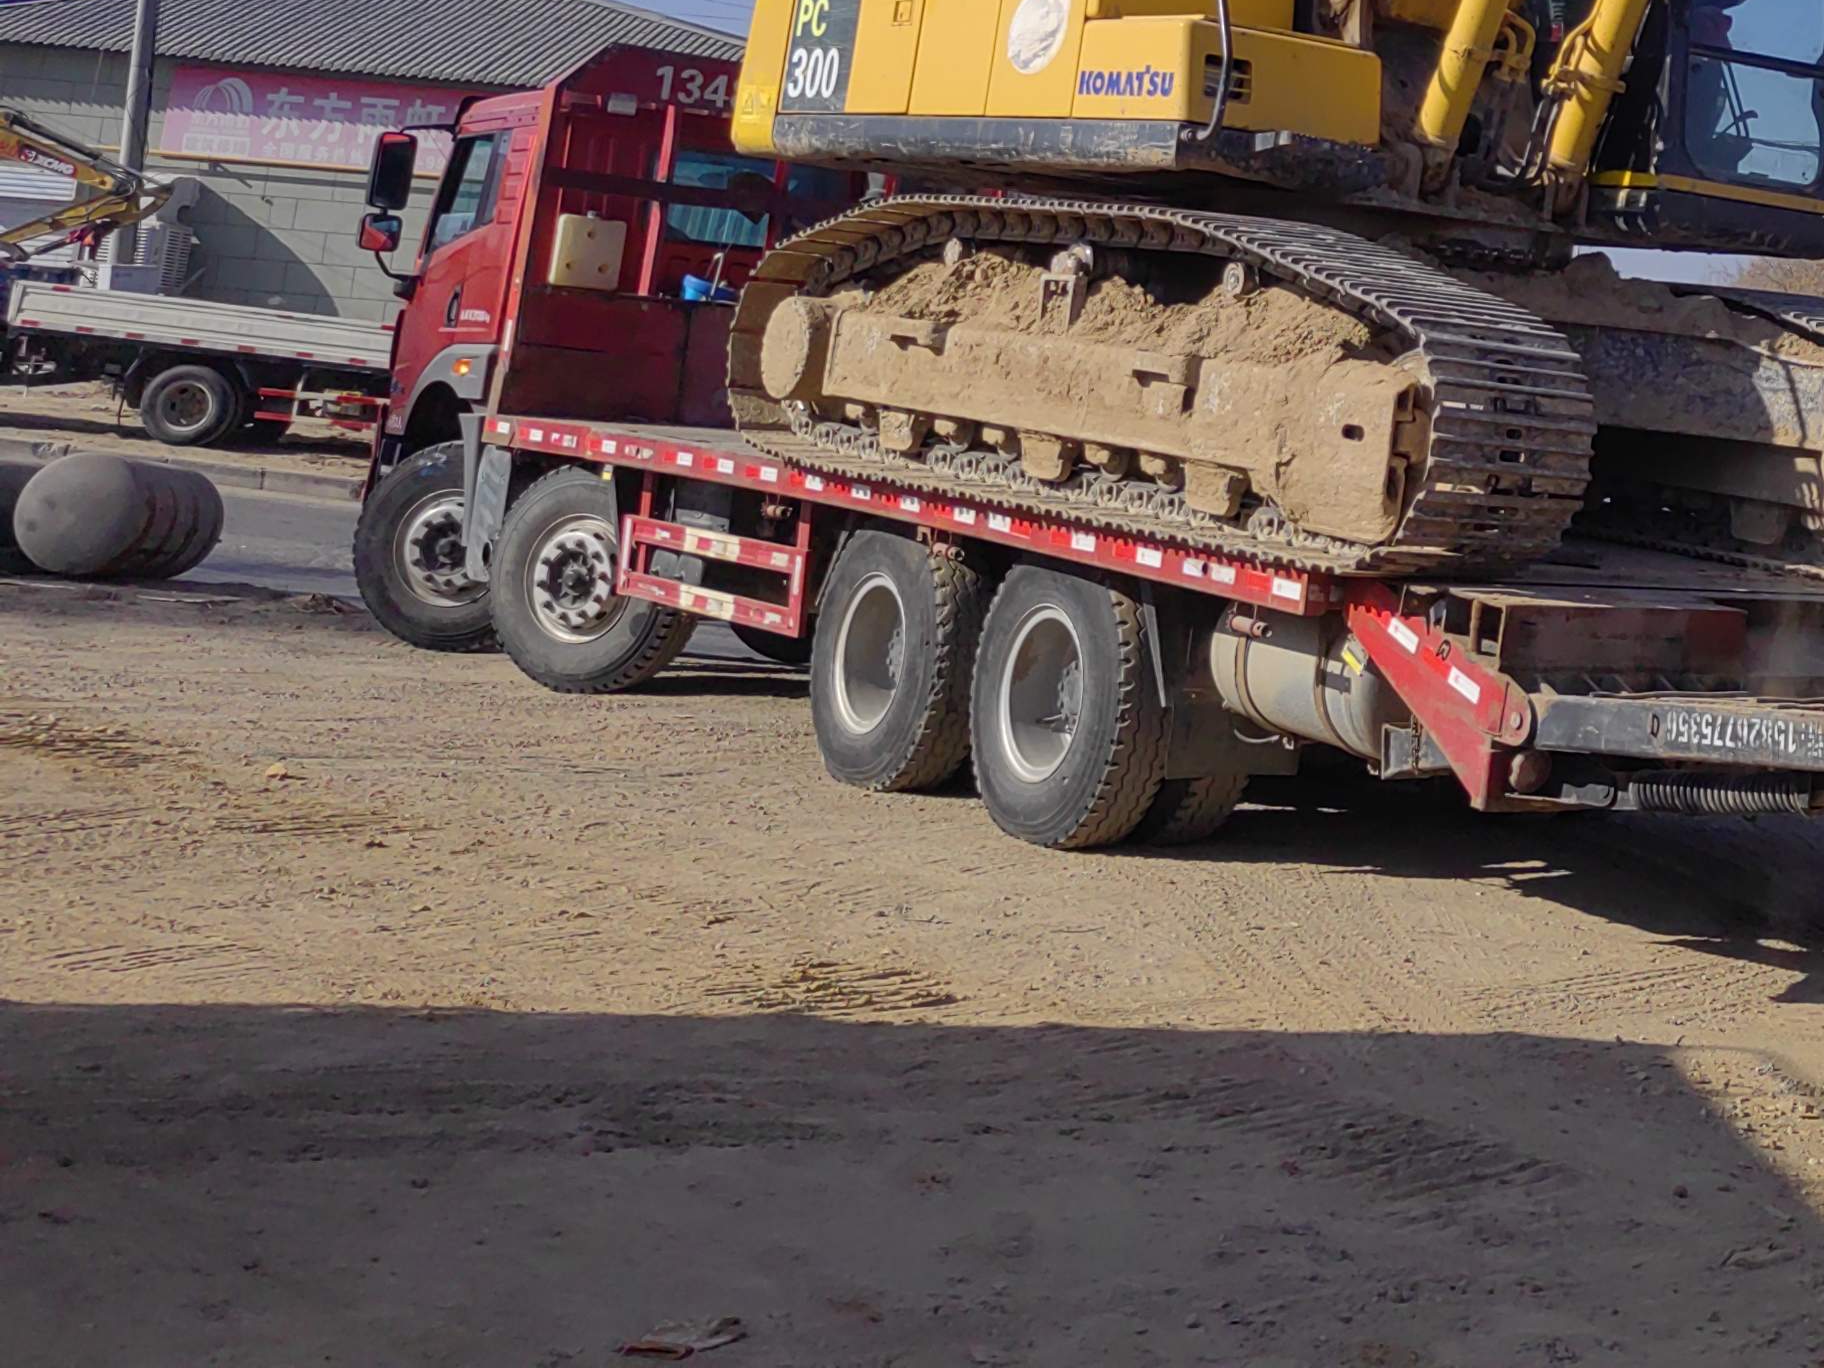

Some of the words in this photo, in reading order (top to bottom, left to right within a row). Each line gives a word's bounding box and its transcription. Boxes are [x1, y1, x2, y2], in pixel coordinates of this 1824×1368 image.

[656, 65, 739, 109] 134
[786, 47, 840, 98] 300
[1077, 64, 1175, 97] KOMATSU
[261, 86, 458, 150] 东方雨虹
